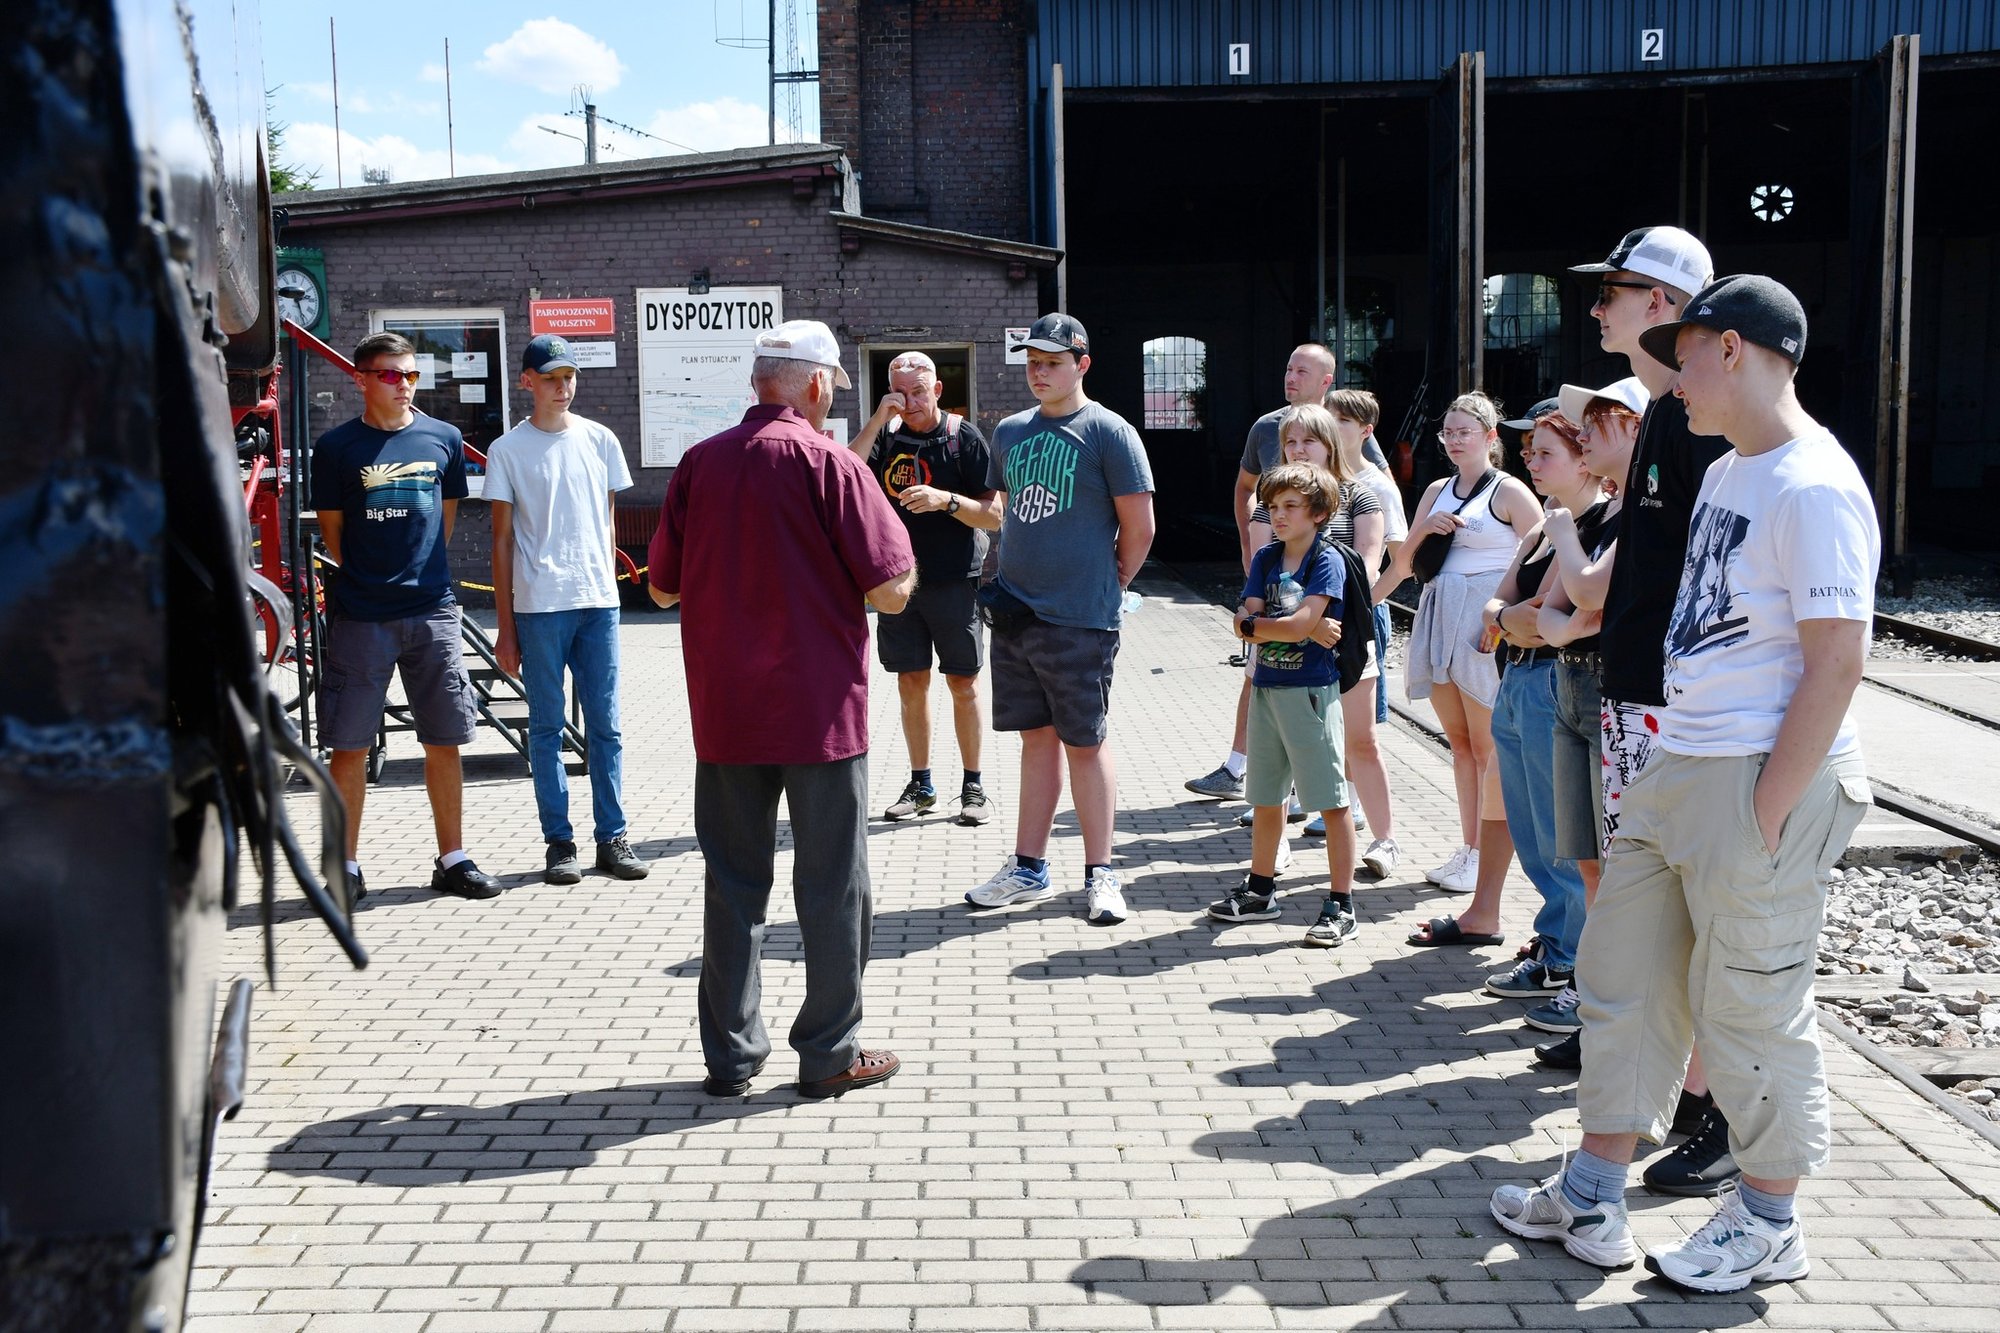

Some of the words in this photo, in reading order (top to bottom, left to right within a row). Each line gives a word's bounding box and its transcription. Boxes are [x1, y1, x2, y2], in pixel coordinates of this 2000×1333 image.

[1645, 32, 1660, 57] 2
[1233, 47, 1242, 71] 1
[536, 307, 608, 317] PAROWOZOWNIA
[646, 302, 774, 331] DYSPOZYTOR
[549, 319, 596, 328] WOLSZTYN
[681, 356, 698, 364] PLAN
[700, 355, 741, 363] SYTUACYJNY
[1006, 431, 1079, 513] REEBOK
[1012, 484, 1058, 524] 1895
[366, 508, 385, 522] Big
[386, 508, 408, 518] Star
[1809, 586, 1857, 598] BATMAN
[1280, 662, 1303, 670] SLEEP
